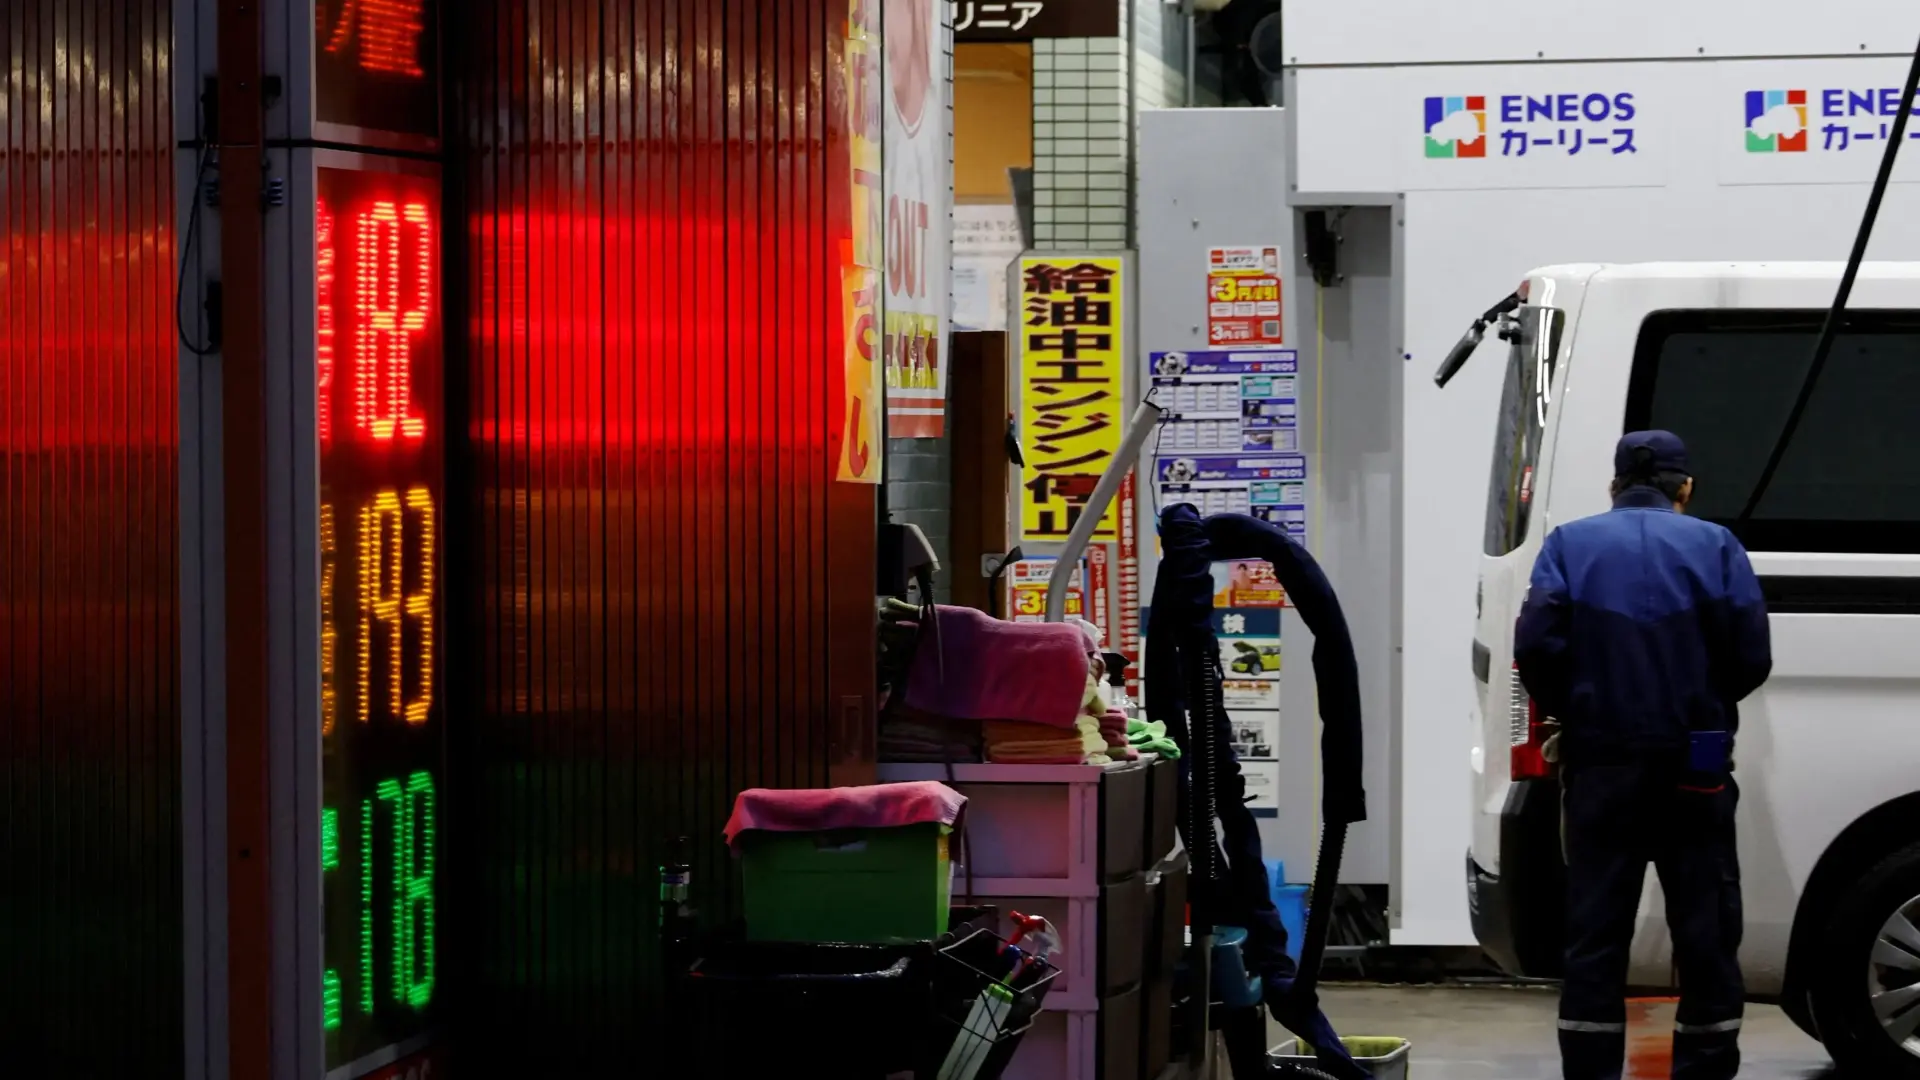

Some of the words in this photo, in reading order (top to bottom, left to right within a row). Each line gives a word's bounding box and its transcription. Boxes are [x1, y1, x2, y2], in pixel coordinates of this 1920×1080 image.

[1500, 129, 1637, 157] カーリース
[1501, 93, 1635, 122] ENEOS
[355, 201, 430, 439] 182
[887, 195, 929, 300] OUT
[1022, 262, 1117, 536] 給油中エンジン停止
[356, 487, 434, 725] 193
